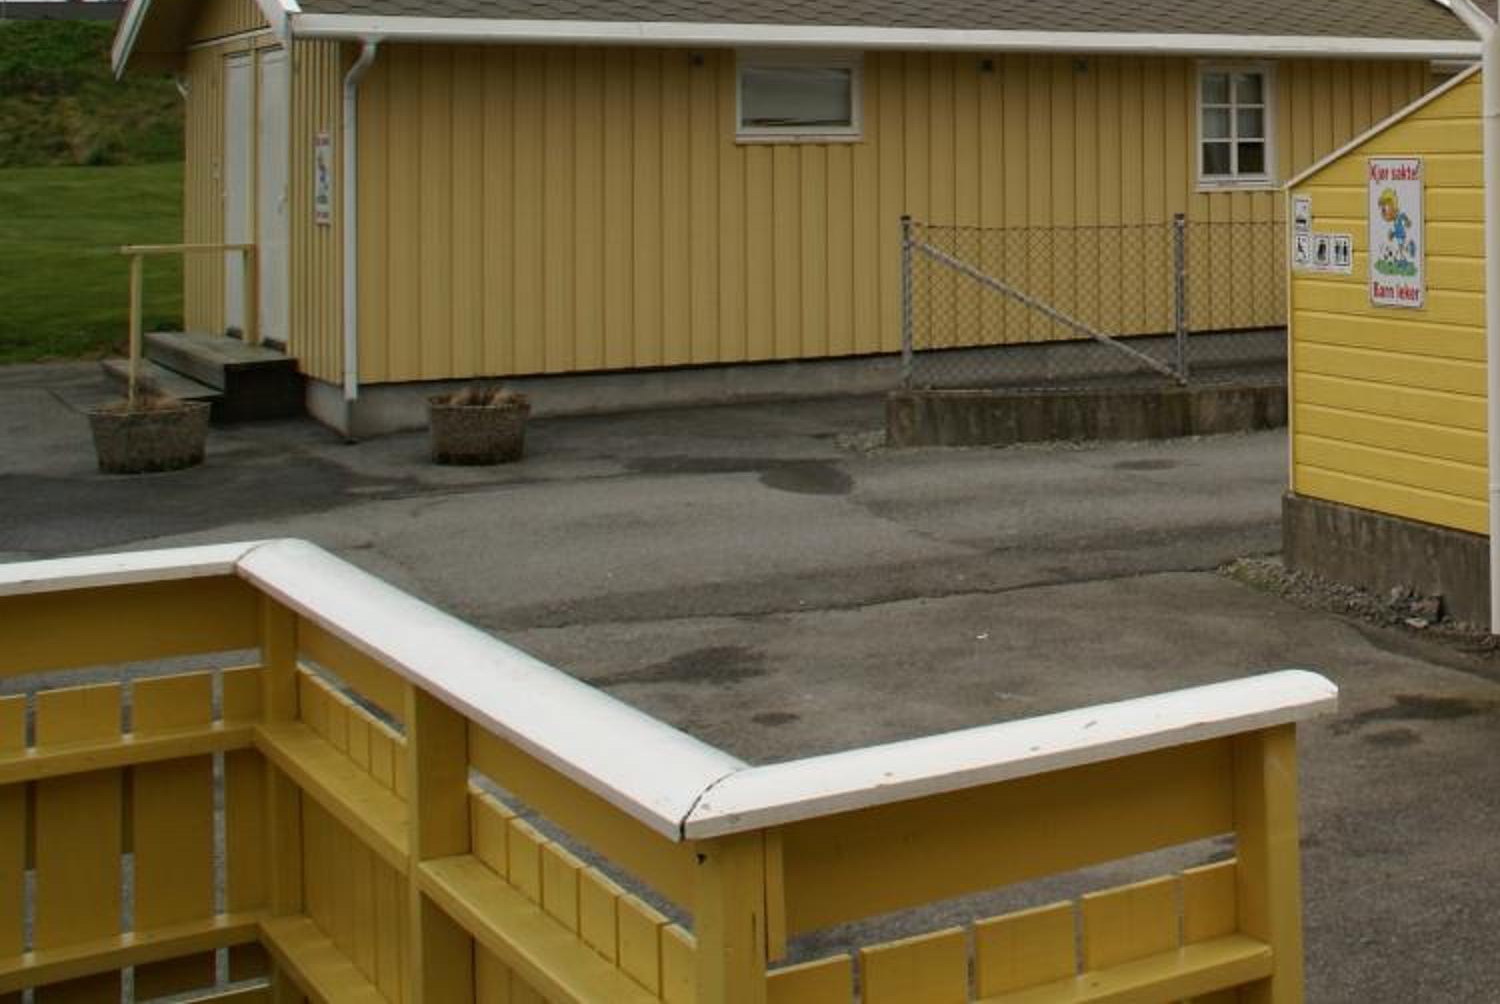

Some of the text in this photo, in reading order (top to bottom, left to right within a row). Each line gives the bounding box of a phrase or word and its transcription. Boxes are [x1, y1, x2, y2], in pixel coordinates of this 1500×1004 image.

[1369, 164, 1418, 184] Kjør sakte!
[1373, 282, 1419, 301] Barn leker
